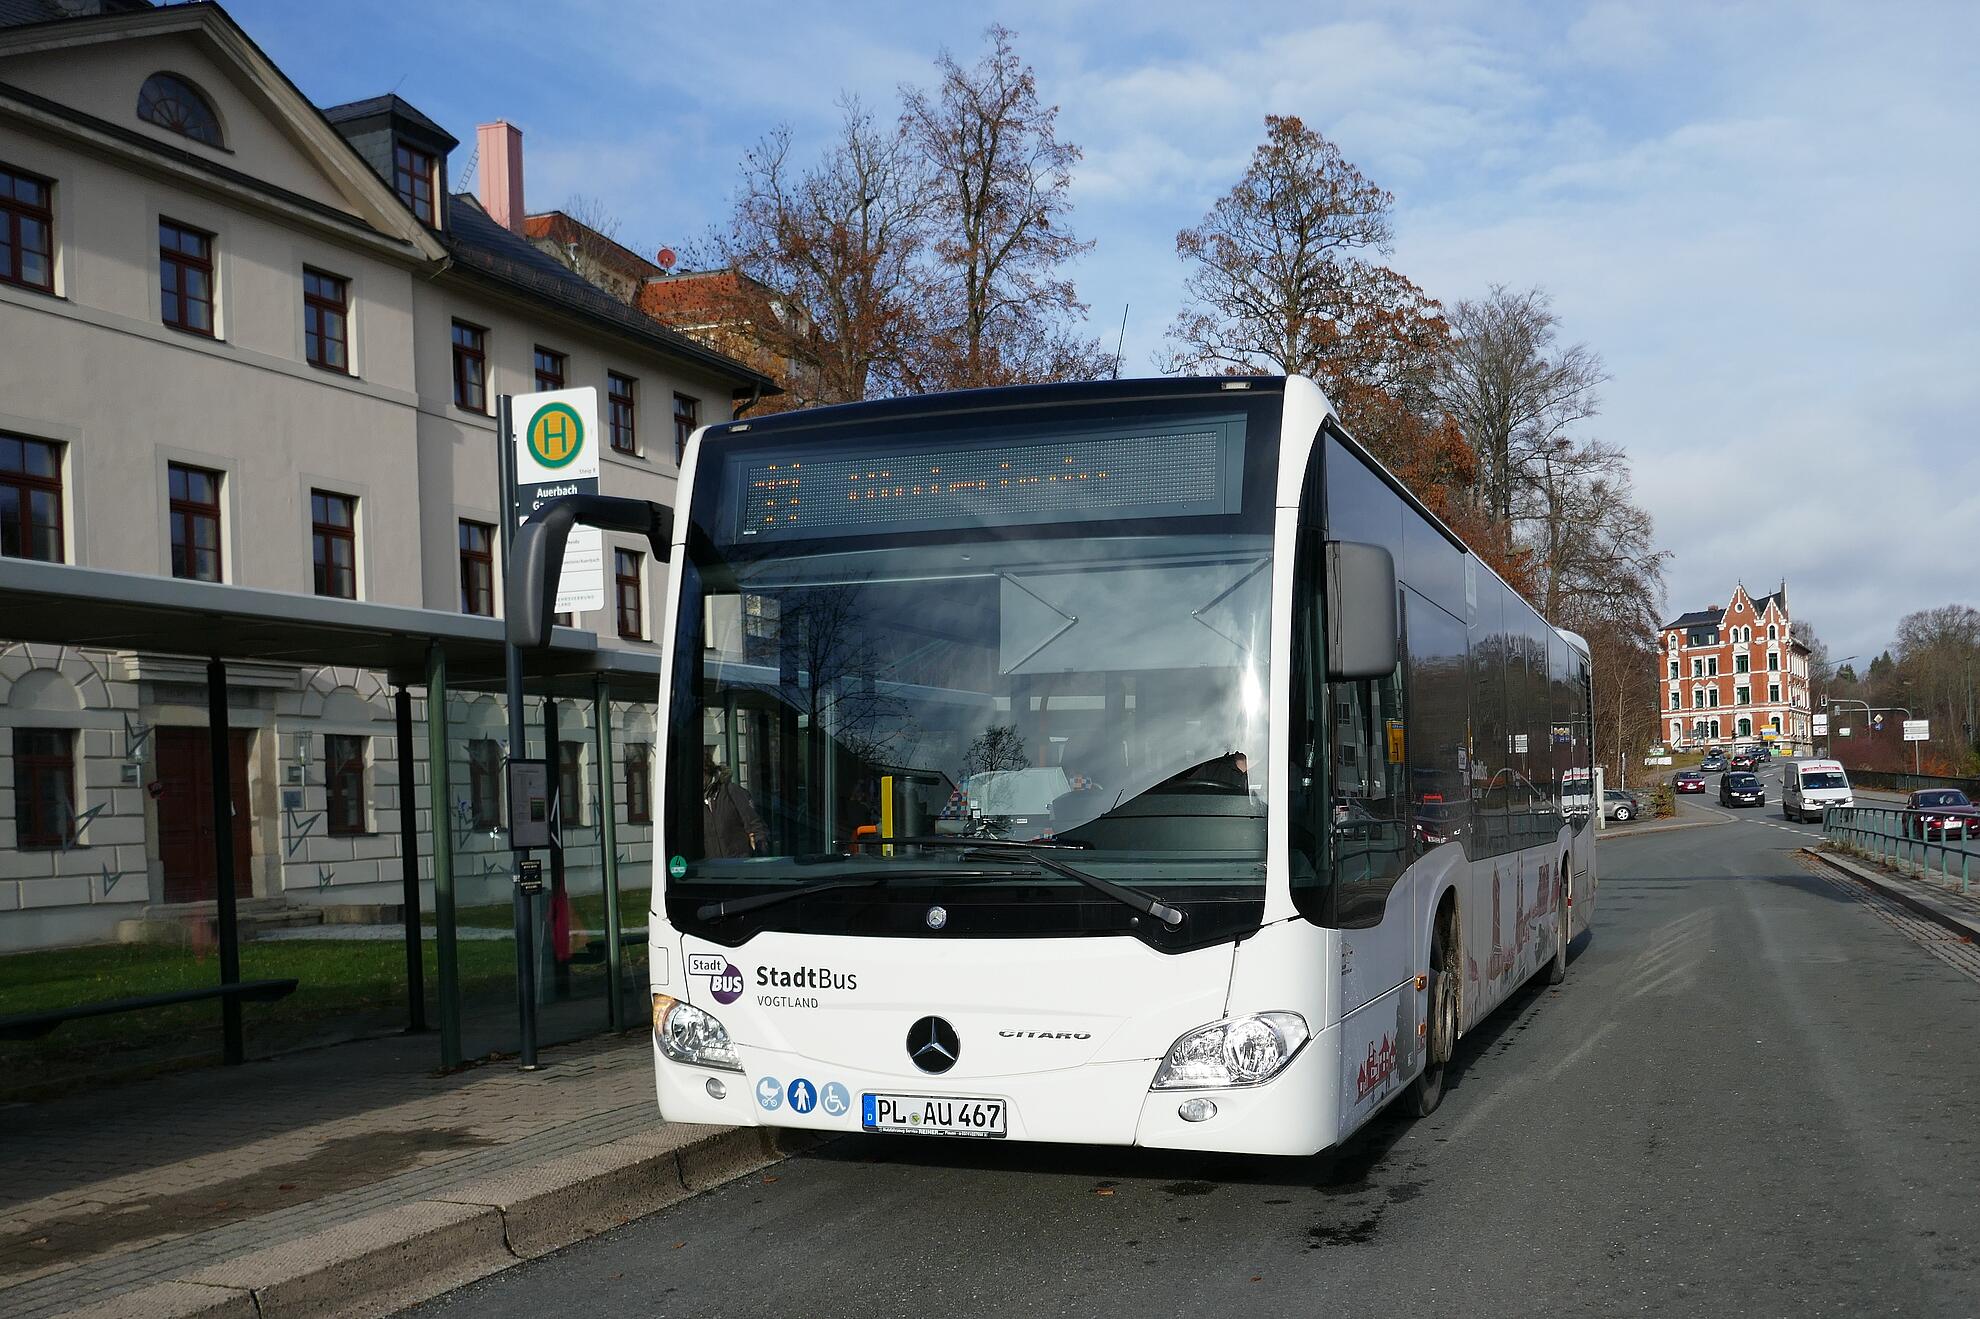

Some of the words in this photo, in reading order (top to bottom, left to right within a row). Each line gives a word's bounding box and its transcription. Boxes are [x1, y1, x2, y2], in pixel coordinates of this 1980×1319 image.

[543, 417, 568, 454] H
[536, 484, 578, 498] Auerbach
[693, 959, 722, 971] Stadt
[711, 976, 743, 993] BUS
[756, 966, 857, 990] StadtBus
[757, 995, 819, 1009] VOGTLAND
[998, 1029, 1091, 1039] CITARO
[877, 1099, 907, 1124] PL
[923, 1102, 952, 1126] AU
[958, 1103, 1001, 1128] 467
